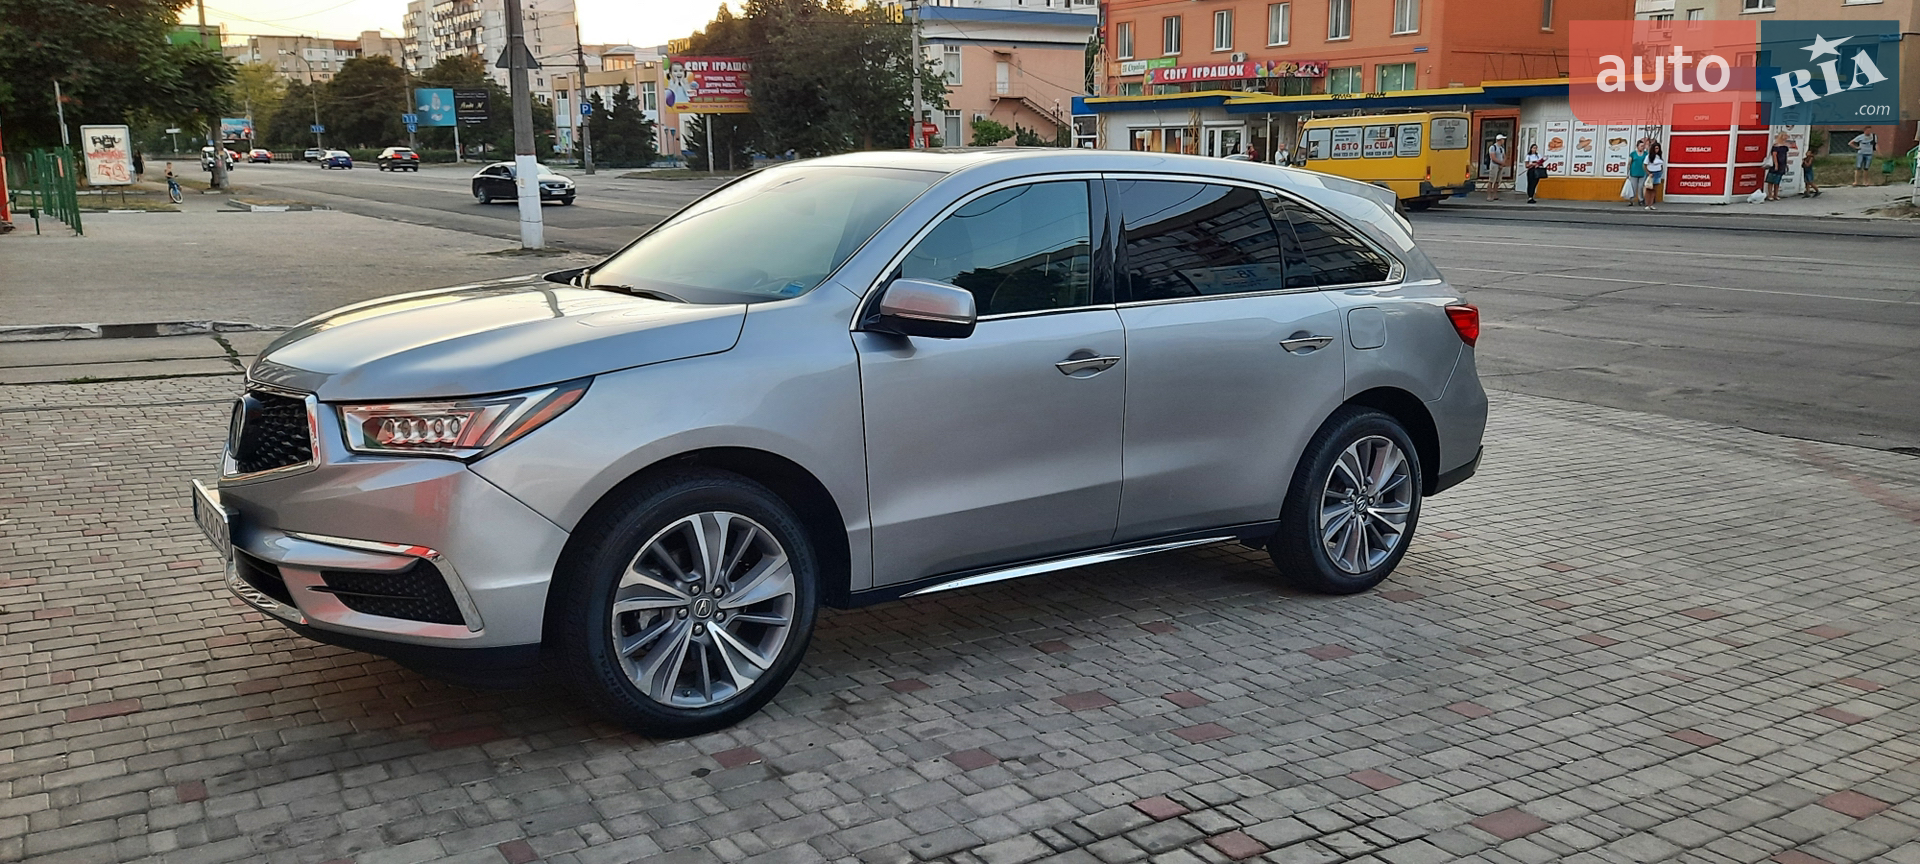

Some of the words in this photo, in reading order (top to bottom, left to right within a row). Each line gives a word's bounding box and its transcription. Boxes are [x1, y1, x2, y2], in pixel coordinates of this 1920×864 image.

[684, 61, 708, 71] СВІТ
[712, 61, 751, 71] ІГРАШО
[1163, 67, 1187, 81] СВІТ
[1192, 64, 1244, 79] ІГРАШОК
[581, 104, 589, 114] P
[1334, 143, 1359, 151] АВТО
[1374, 141, 1394, 150] США
[1546, 163, 1558, 172] 48
[1573, 163, 1586, 172] 58
[1606, 163, 1619, 172] 68
